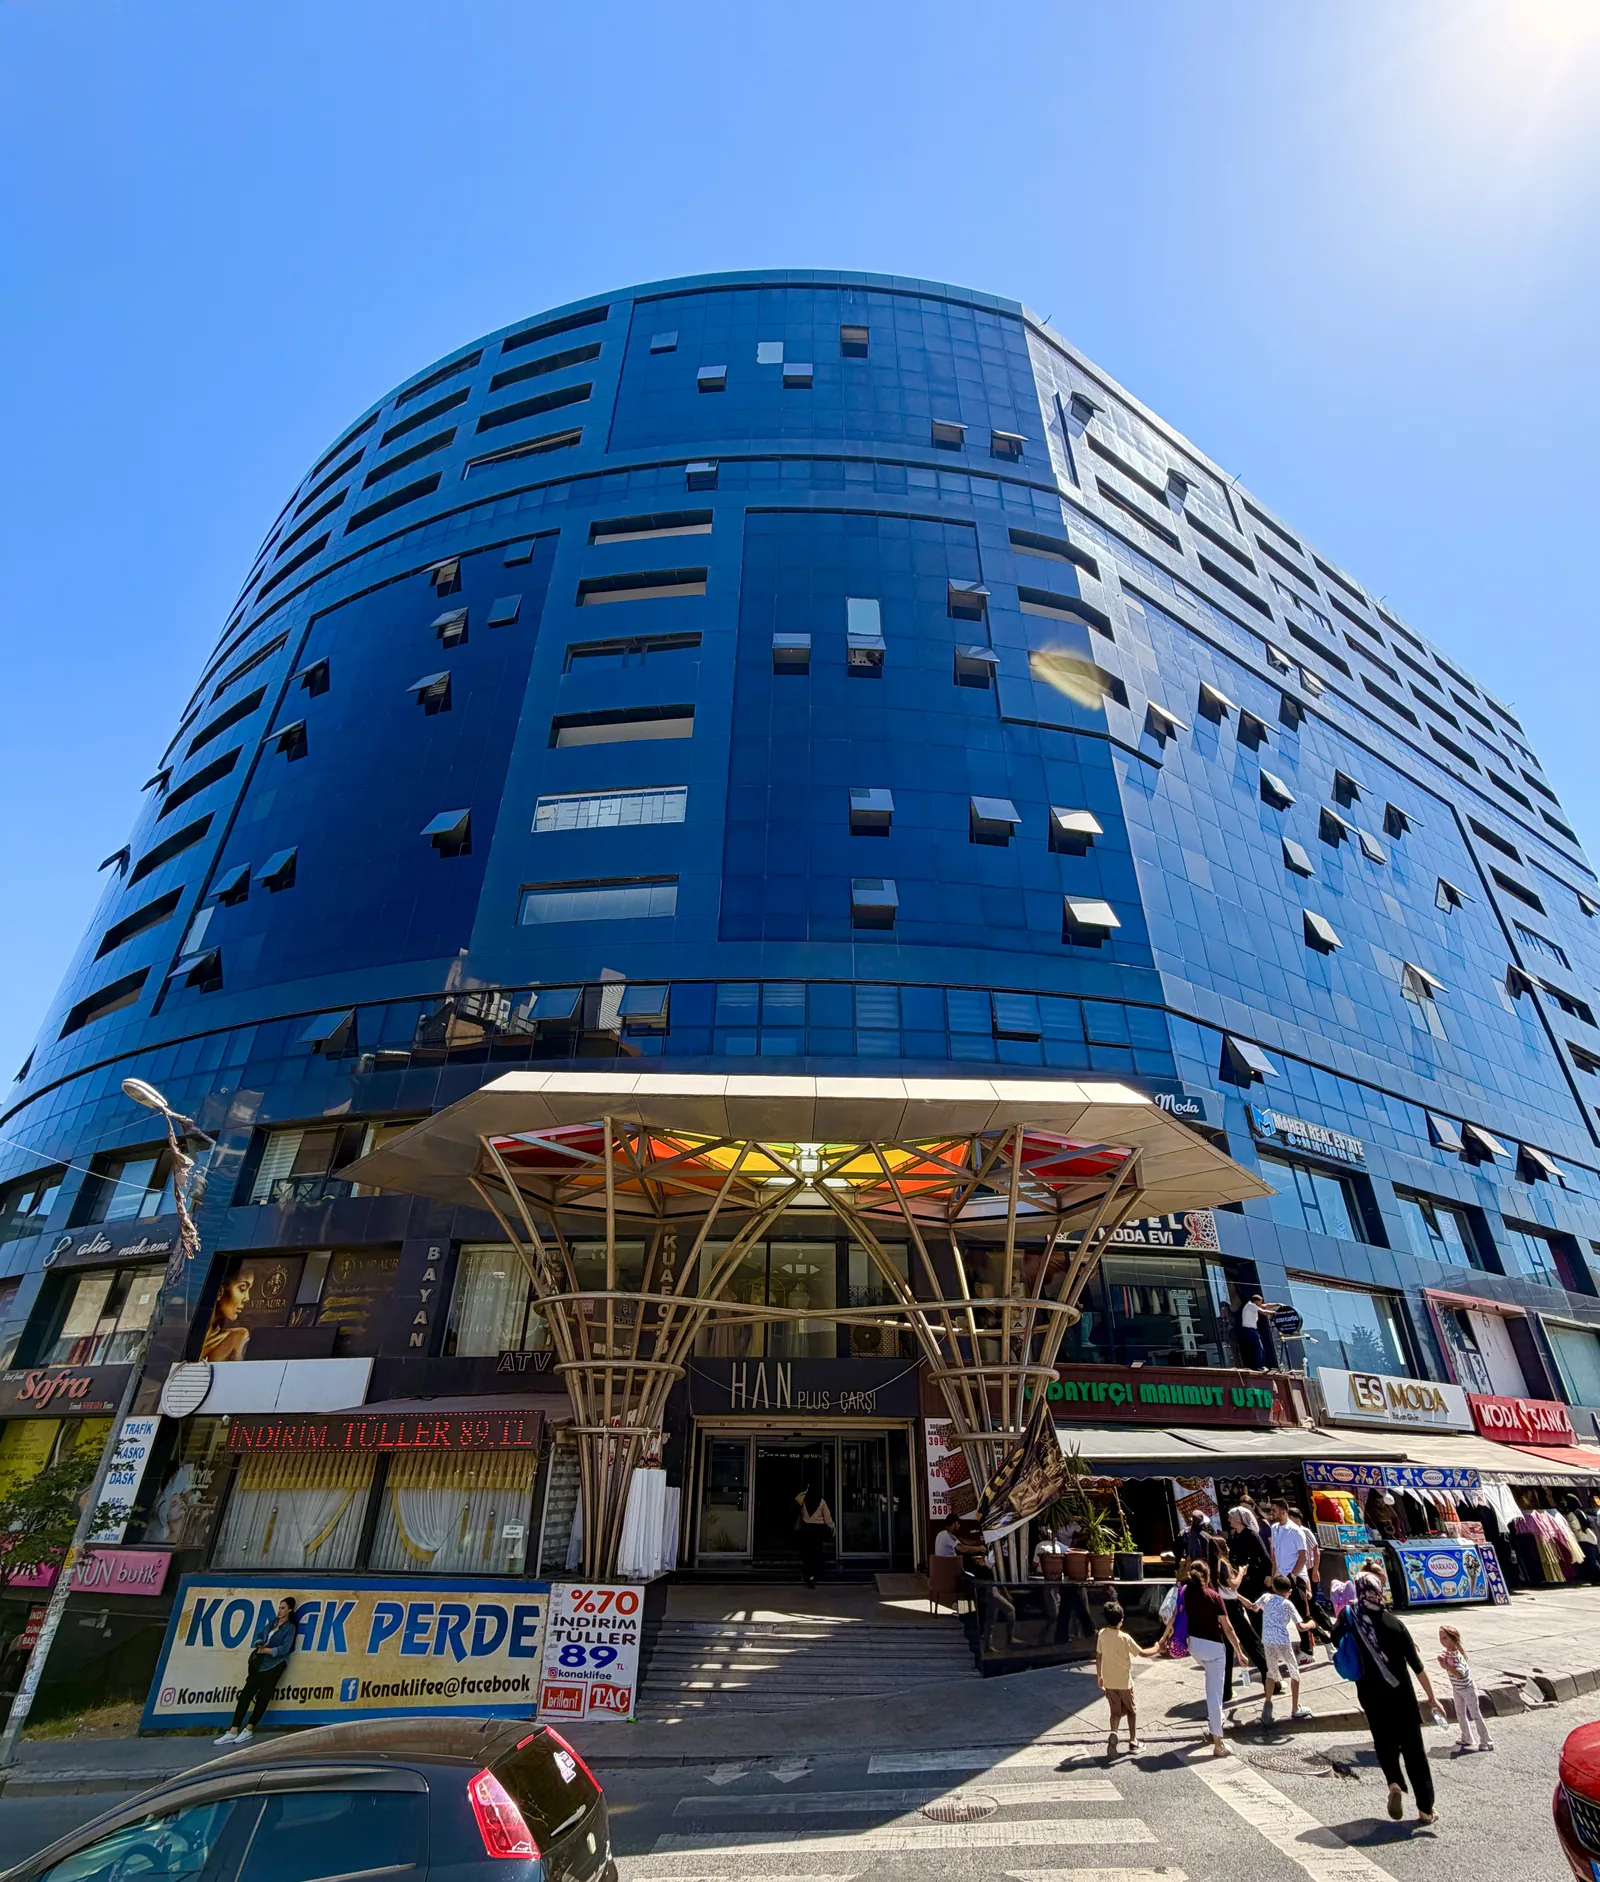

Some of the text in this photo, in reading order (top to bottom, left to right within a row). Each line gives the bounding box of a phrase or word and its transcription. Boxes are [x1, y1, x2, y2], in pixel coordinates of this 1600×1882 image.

[1154, 1093, 1200, 1115] Moda
[1272, 1112, 1365, 1158] MAHER REAL ESTATE
[408, 1246, 441, 1348] BAYAN
[496, 1352, 551, 1373] ATV
[15, 1369, 92, 1409] Sofra
[731, 1361, 876, 1414] HAN PLUS ÇARŞI
[1139, 1383, 1224, 1407] MAHMUT
[1231, 1387, 1273, 1409] USTA
[1353, 1377, 1450, 1414] ES MODA
[124, 1420, 154, 1435] TRAFİK
[1478, 1403, 1523, 1430] MODA
[1527, 1407, 1575, 1433] SANKA
[343, 1415, 452, 1448] TÜLLER
[116, 1447, 145, 1460] KASKO
[108, 1472, 136, 1486] DASK
[117, 1562, 157, 1585] butik
[1430, 1562, 1458, 1570] MARKADO
[570, 1589, 639, 1615] %70
[365, 1600, 541, 1663] PERDE
[553, 1613, 637, 1630] İNDİRİM
[553, 1628, 637, 1646] TÜLLER
[558, 1644, 618, 1669] 89
[360, 1673, 531, 1698] Konaklifee@facebook
[558, 1669, 613, 1681] konaklifee
[546, 1687, 629, 1713] brillant TAÇ
